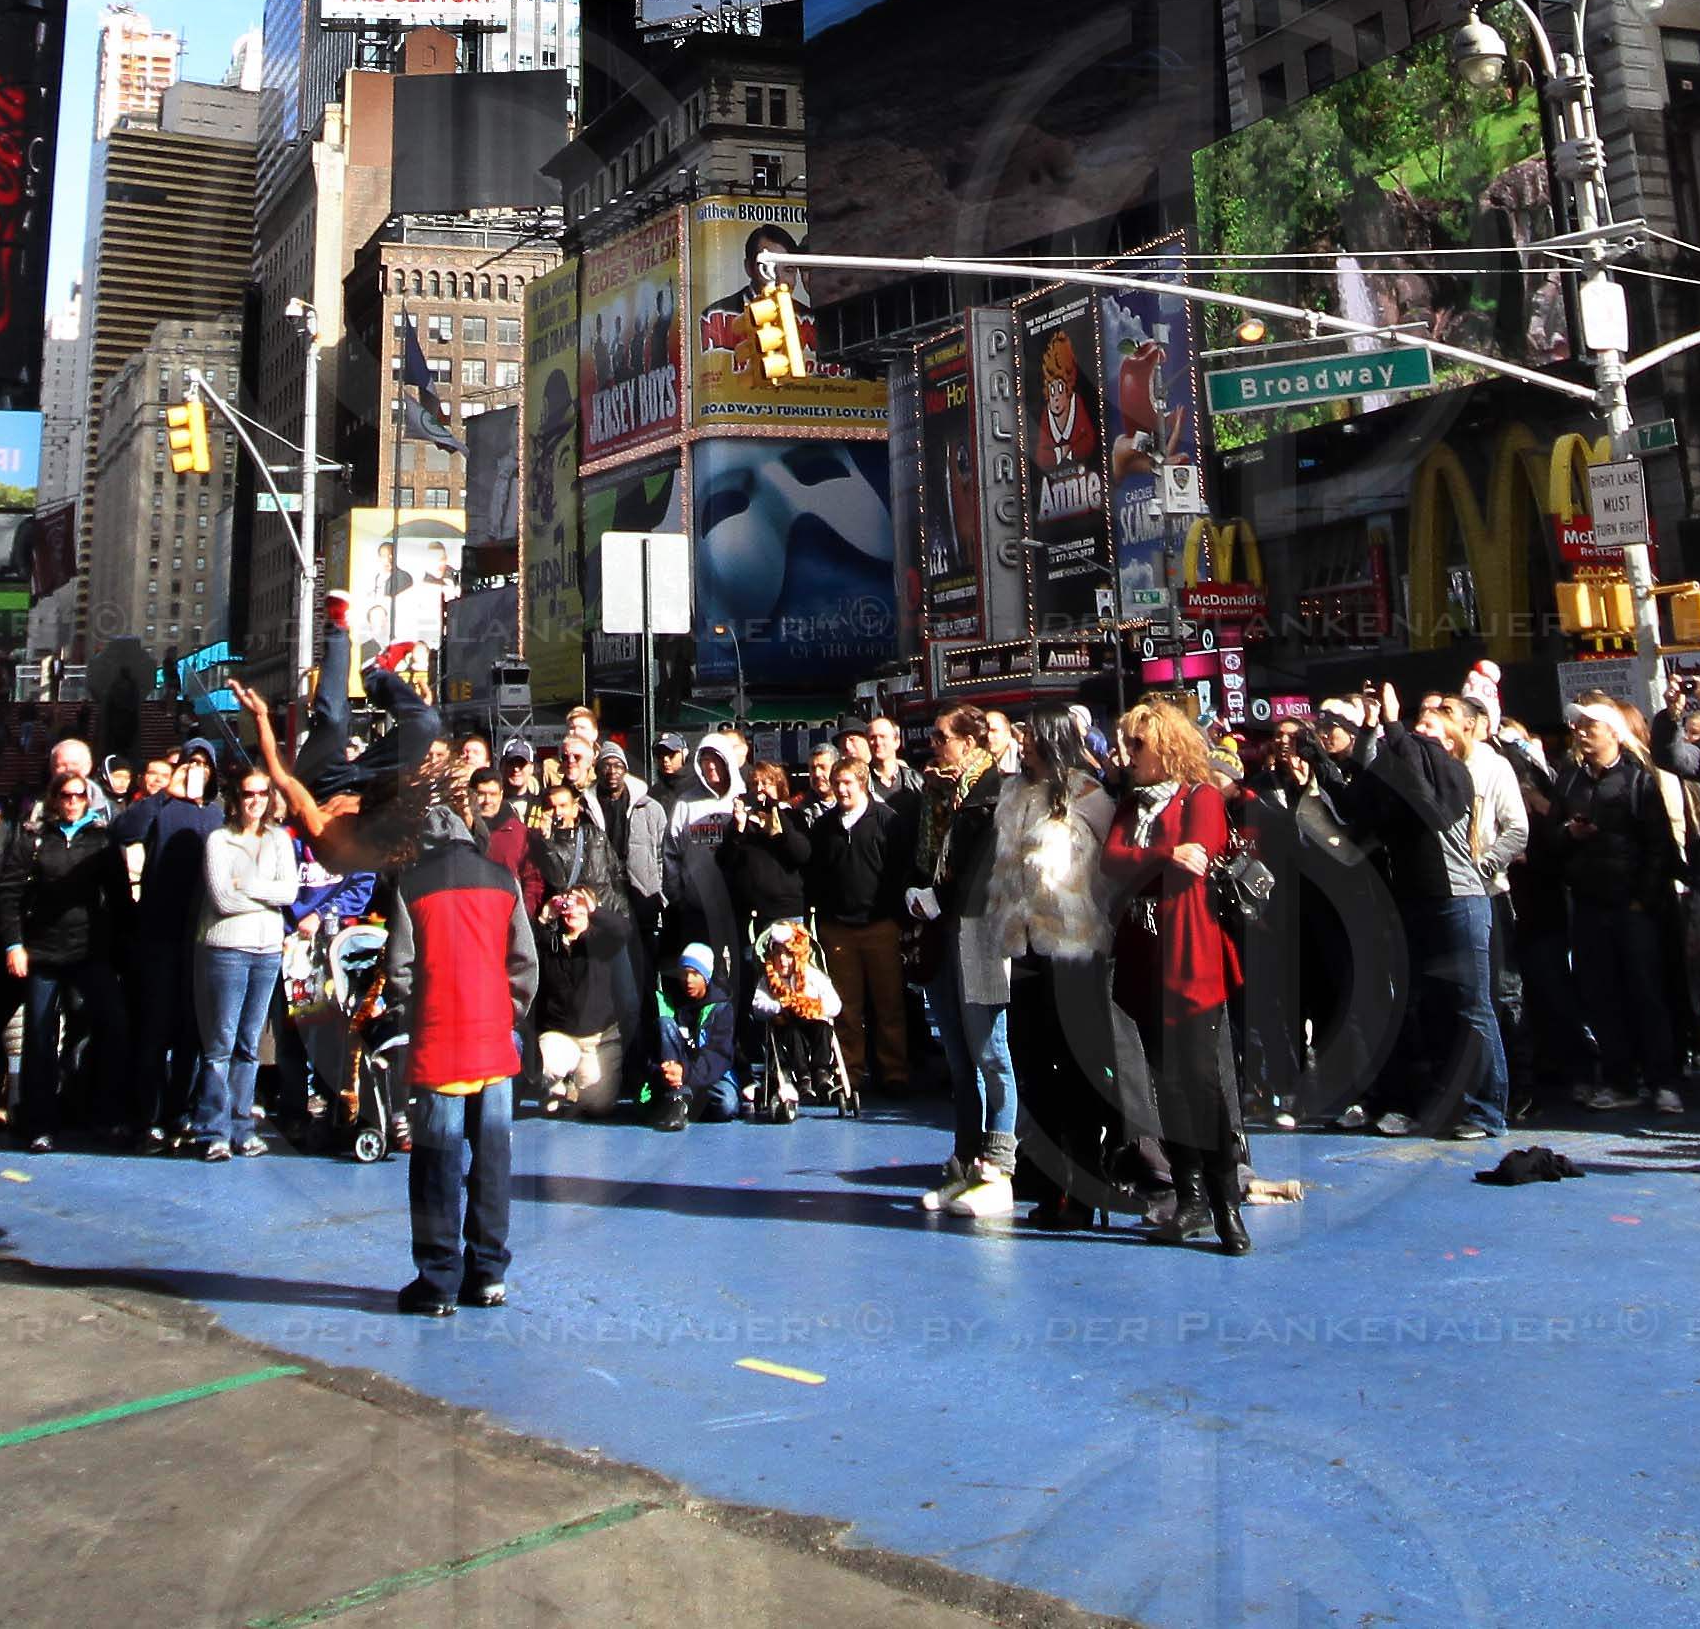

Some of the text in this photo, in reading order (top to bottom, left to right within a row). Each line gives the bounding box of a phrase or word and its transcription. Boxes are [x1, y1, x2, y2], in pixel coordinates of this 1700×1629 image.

[1239, 363, 1395, 401] Broadway
[588, 376, 637, 445] JERSEY
[637, 364, 677, 428] BOYS
[835, 407, 868, 419] LOVE
[987, 328, 1021, 570] PALACE
[1590, 469, 1639, 488] RIGHT LANE
[1039, 467, 1102, 522] Annie
[1603, 494, 1631, 513] MUST
[1595, 519, 1645, 540] TURN RIGHT
[1045, 644, 1091, 669] Annie
